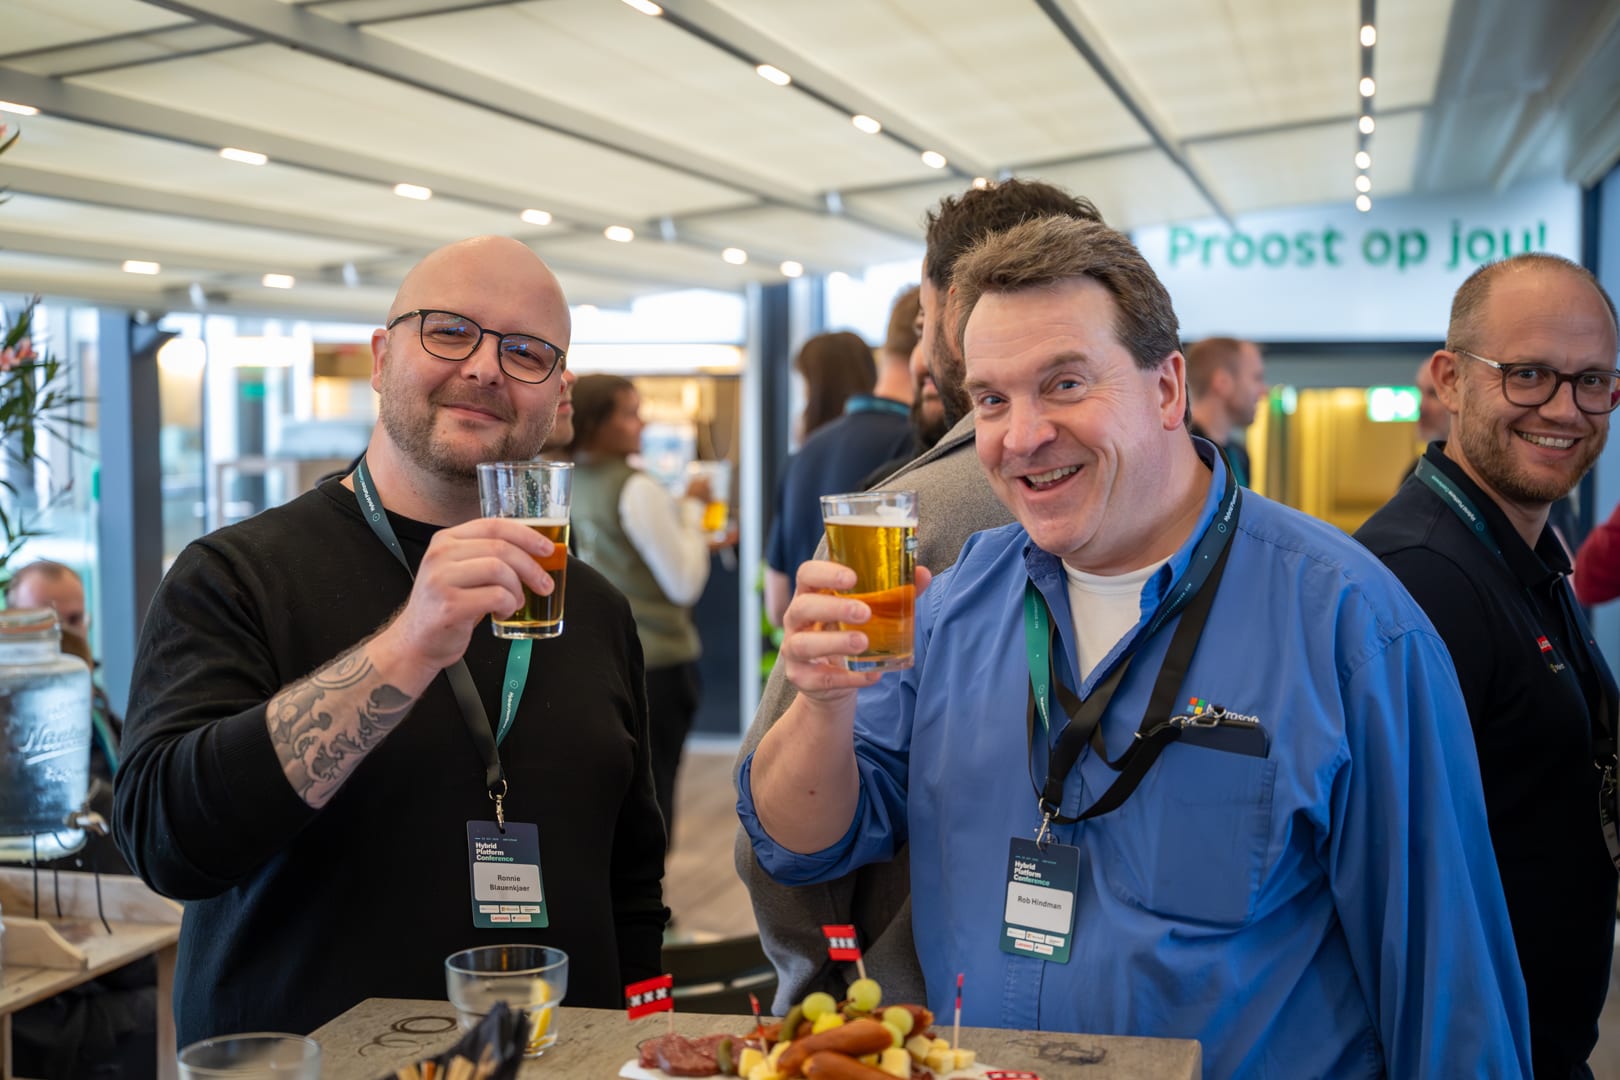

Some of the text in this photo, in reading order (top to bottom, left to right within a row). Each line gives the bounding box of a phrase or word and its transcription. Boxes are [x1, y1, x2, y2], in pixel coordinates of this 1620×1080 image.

[1169, 226, 1341, 267] Proost
[1362, 229, 1428, 270] op
[475, 842, 498, 850] Hybrid
[1014, 860, 1036, 871] Hybrid
[1013, 867, 1042, 879] Platform
[1013, 874, 1050, 887] Conference
[489, 884, 530, 893] Blauenkjaer
[1017, 895, 1062, 910] Rob Hindman
